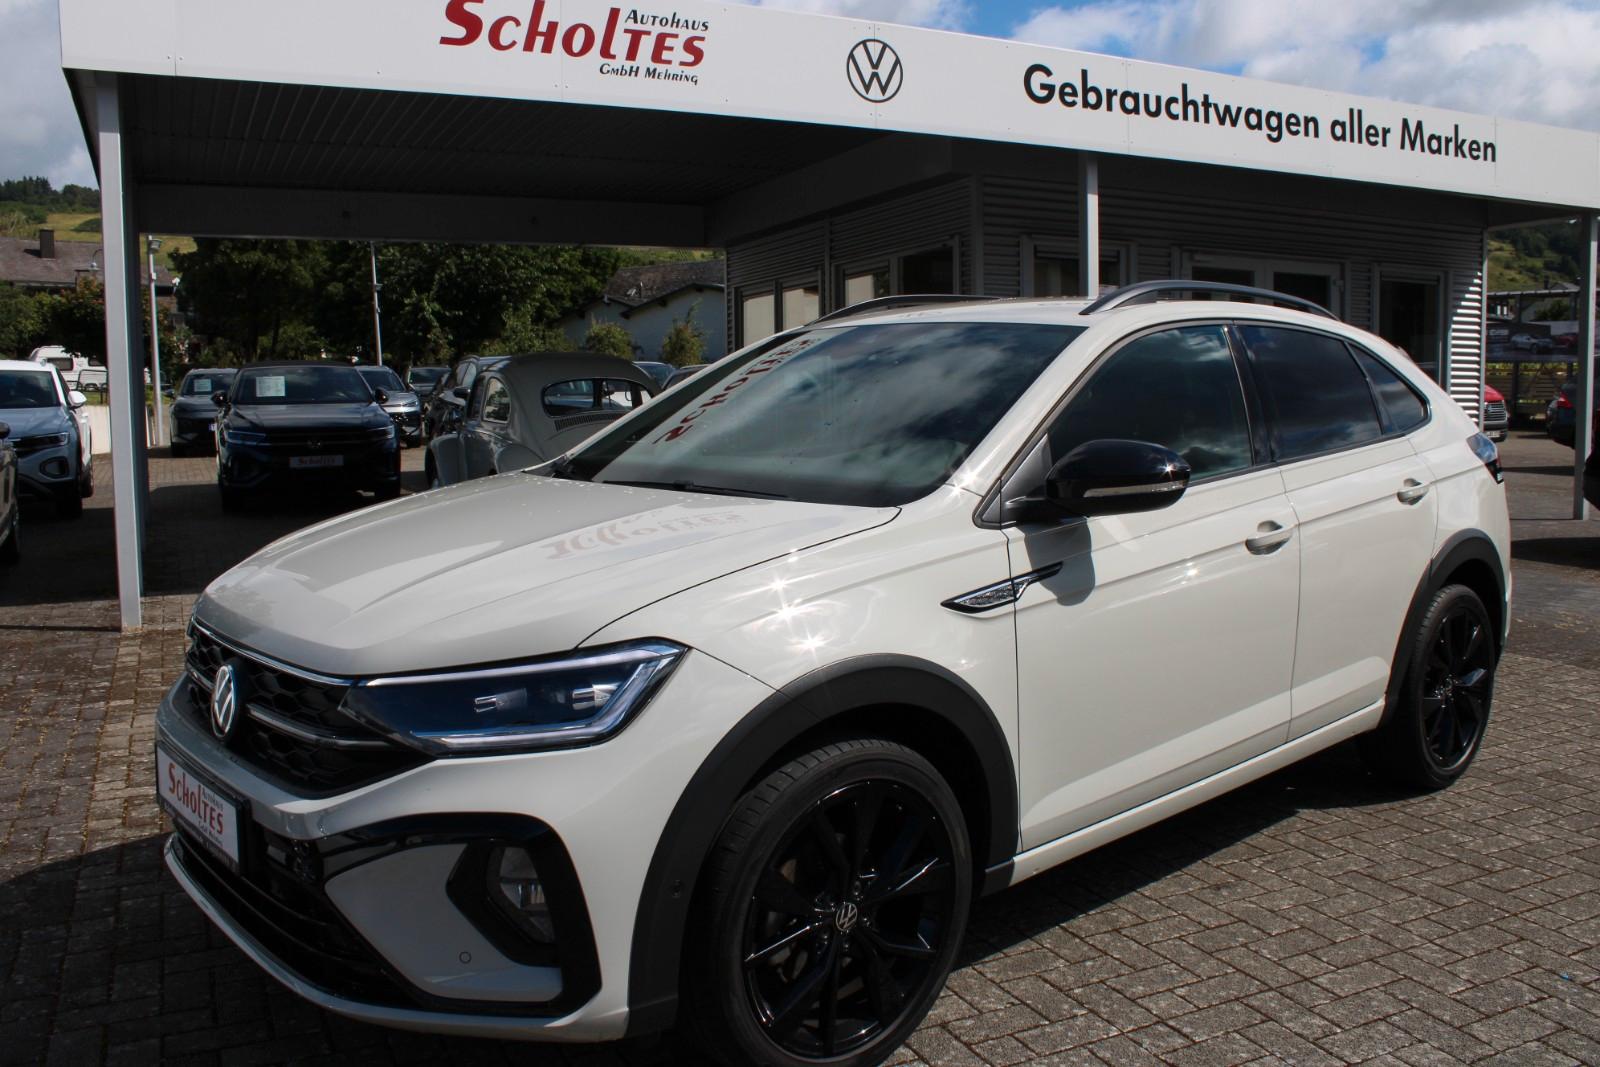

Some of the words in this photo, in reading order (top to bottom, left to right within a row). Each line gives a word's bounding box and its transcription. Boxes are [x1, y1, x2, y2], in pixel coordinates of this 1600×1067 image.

[846, 38, 903, 103] VW
[1024, 63, 1320, 143] Gebrauchtwagen
[1330, 107, 1391, 148] aller
[1400, 117, 1497, 163] Marken
